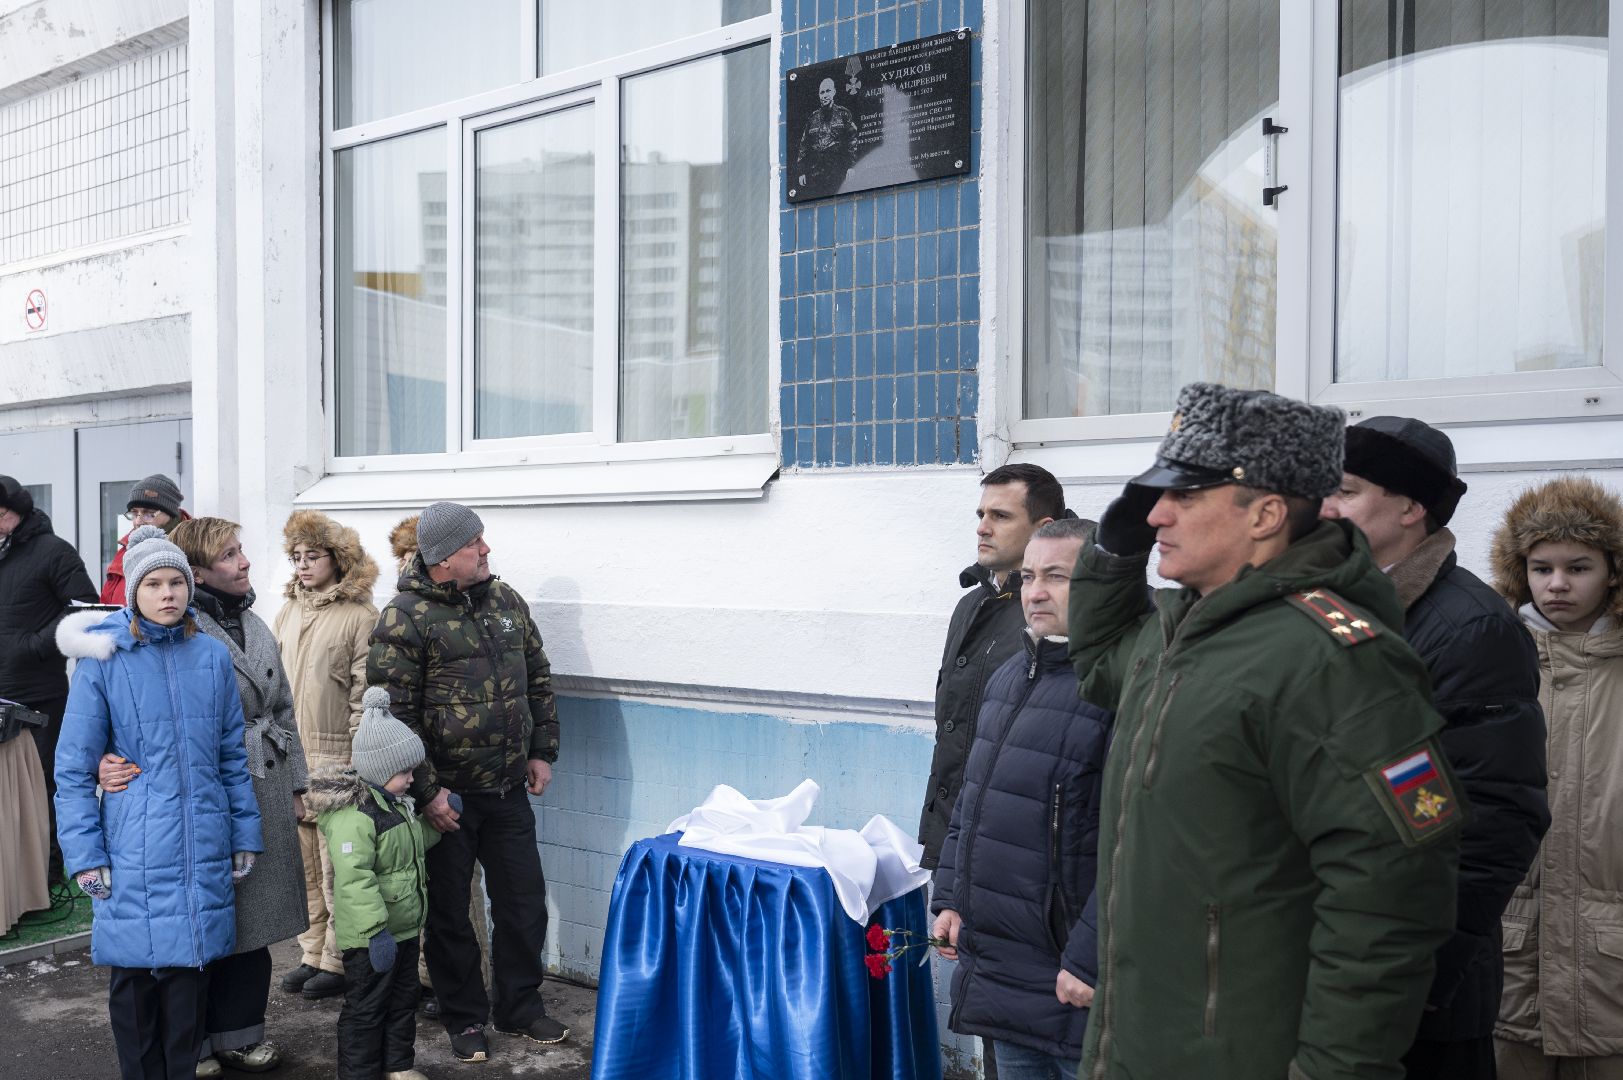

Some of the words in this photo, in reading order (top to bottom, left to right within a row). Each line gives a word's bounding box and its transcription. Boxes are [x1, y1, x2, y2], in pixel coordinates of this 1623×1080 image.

[880, 63, 931, 82] ХУДЯКОВ
[899, 73, 948, 90] АНДРЕЕВИЧ
[929, 106, 943, 115] СВО
